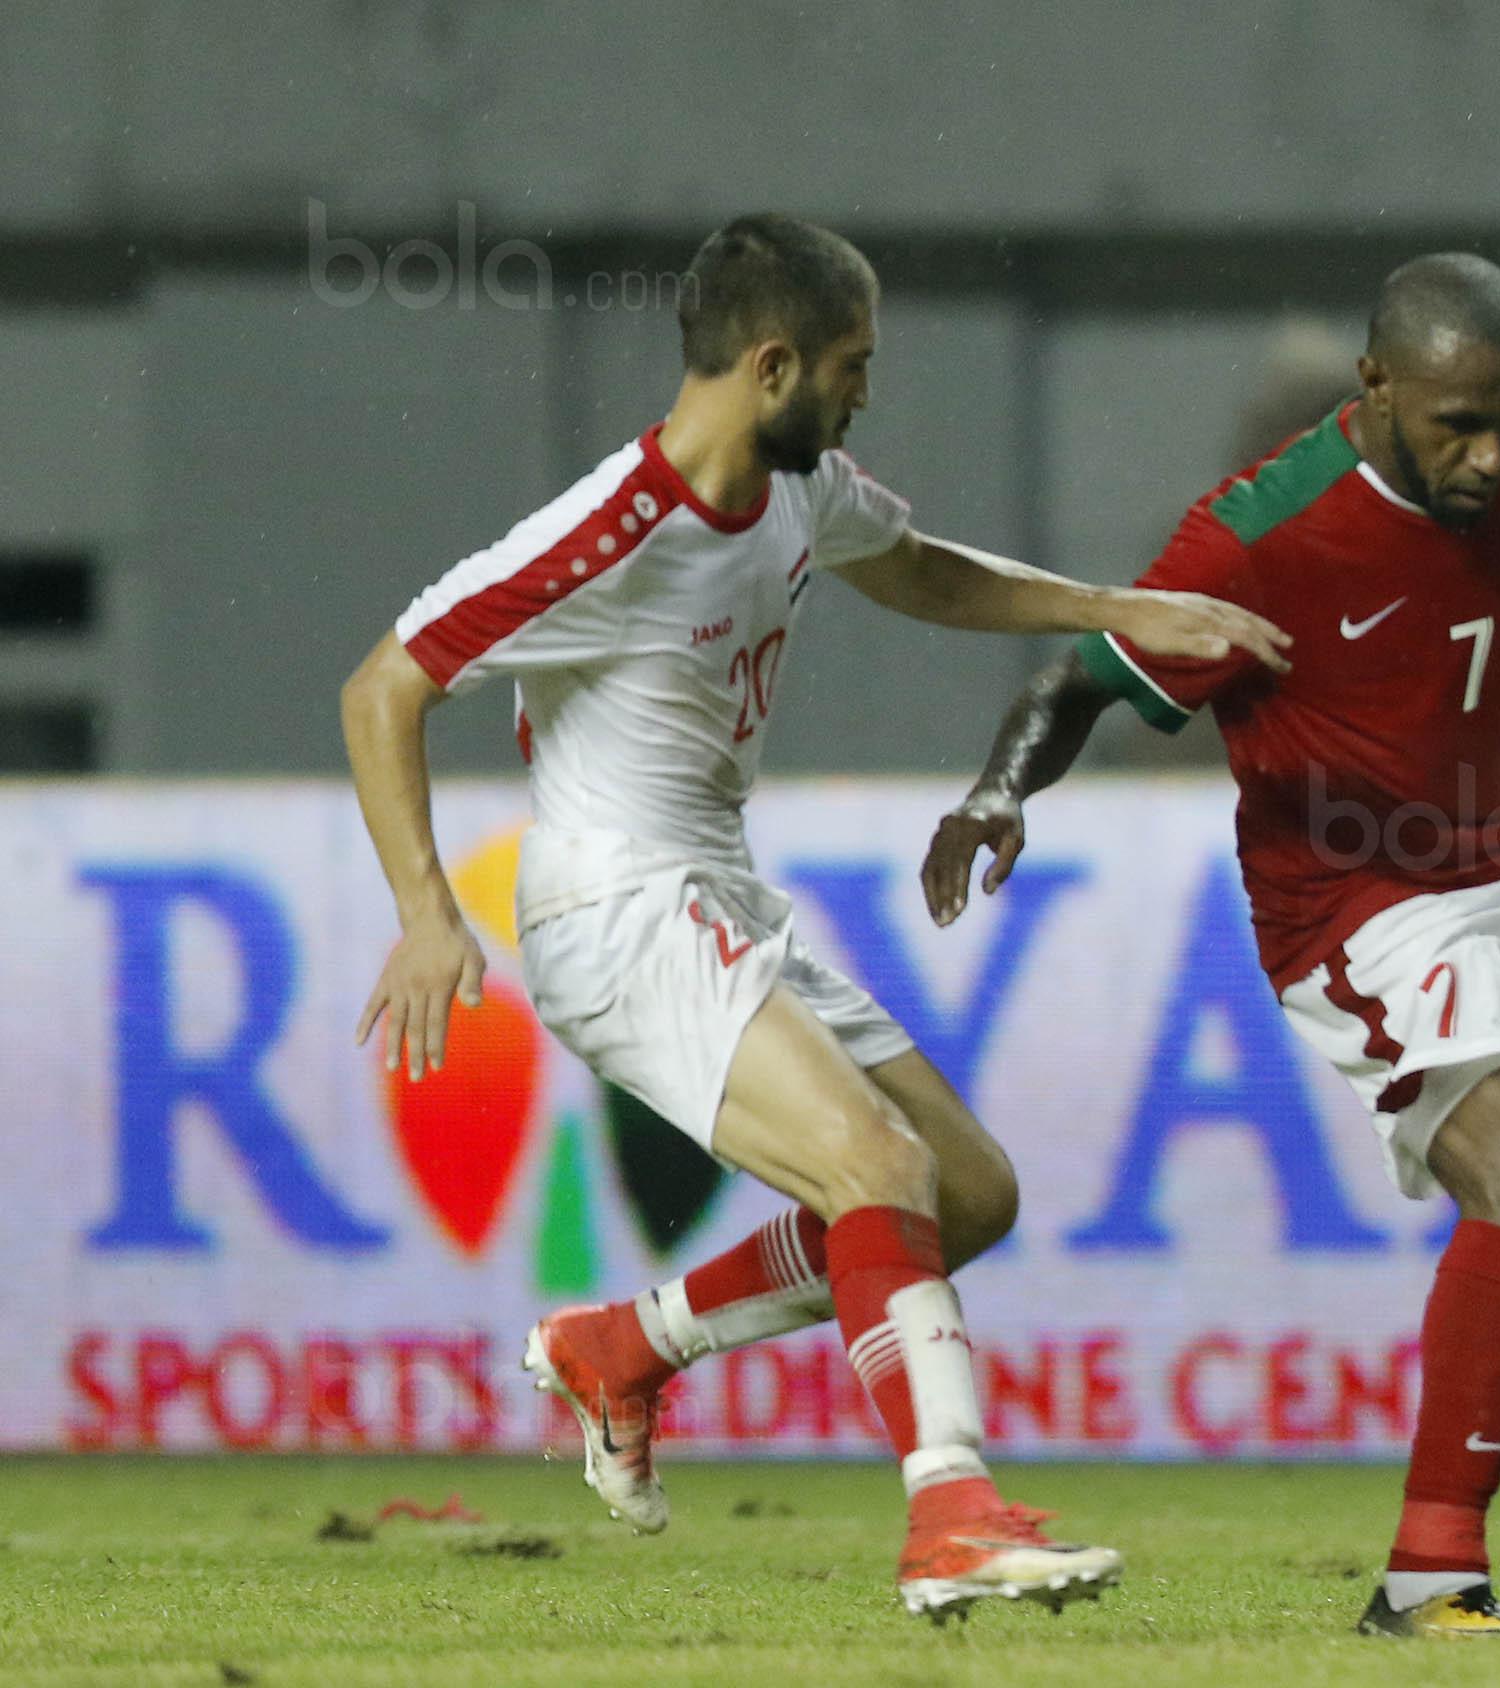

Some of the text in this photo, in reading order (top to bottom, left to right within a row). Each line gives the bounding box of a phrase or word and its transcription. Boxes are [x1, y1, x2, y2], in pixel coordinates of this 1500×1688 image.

[729, 626, 786, 743] 20
[1449, 616, 1494, 713] 7
[1420, 962, 1457, 1038] 7
[66, 1332, 497, 1451] SPORTS
